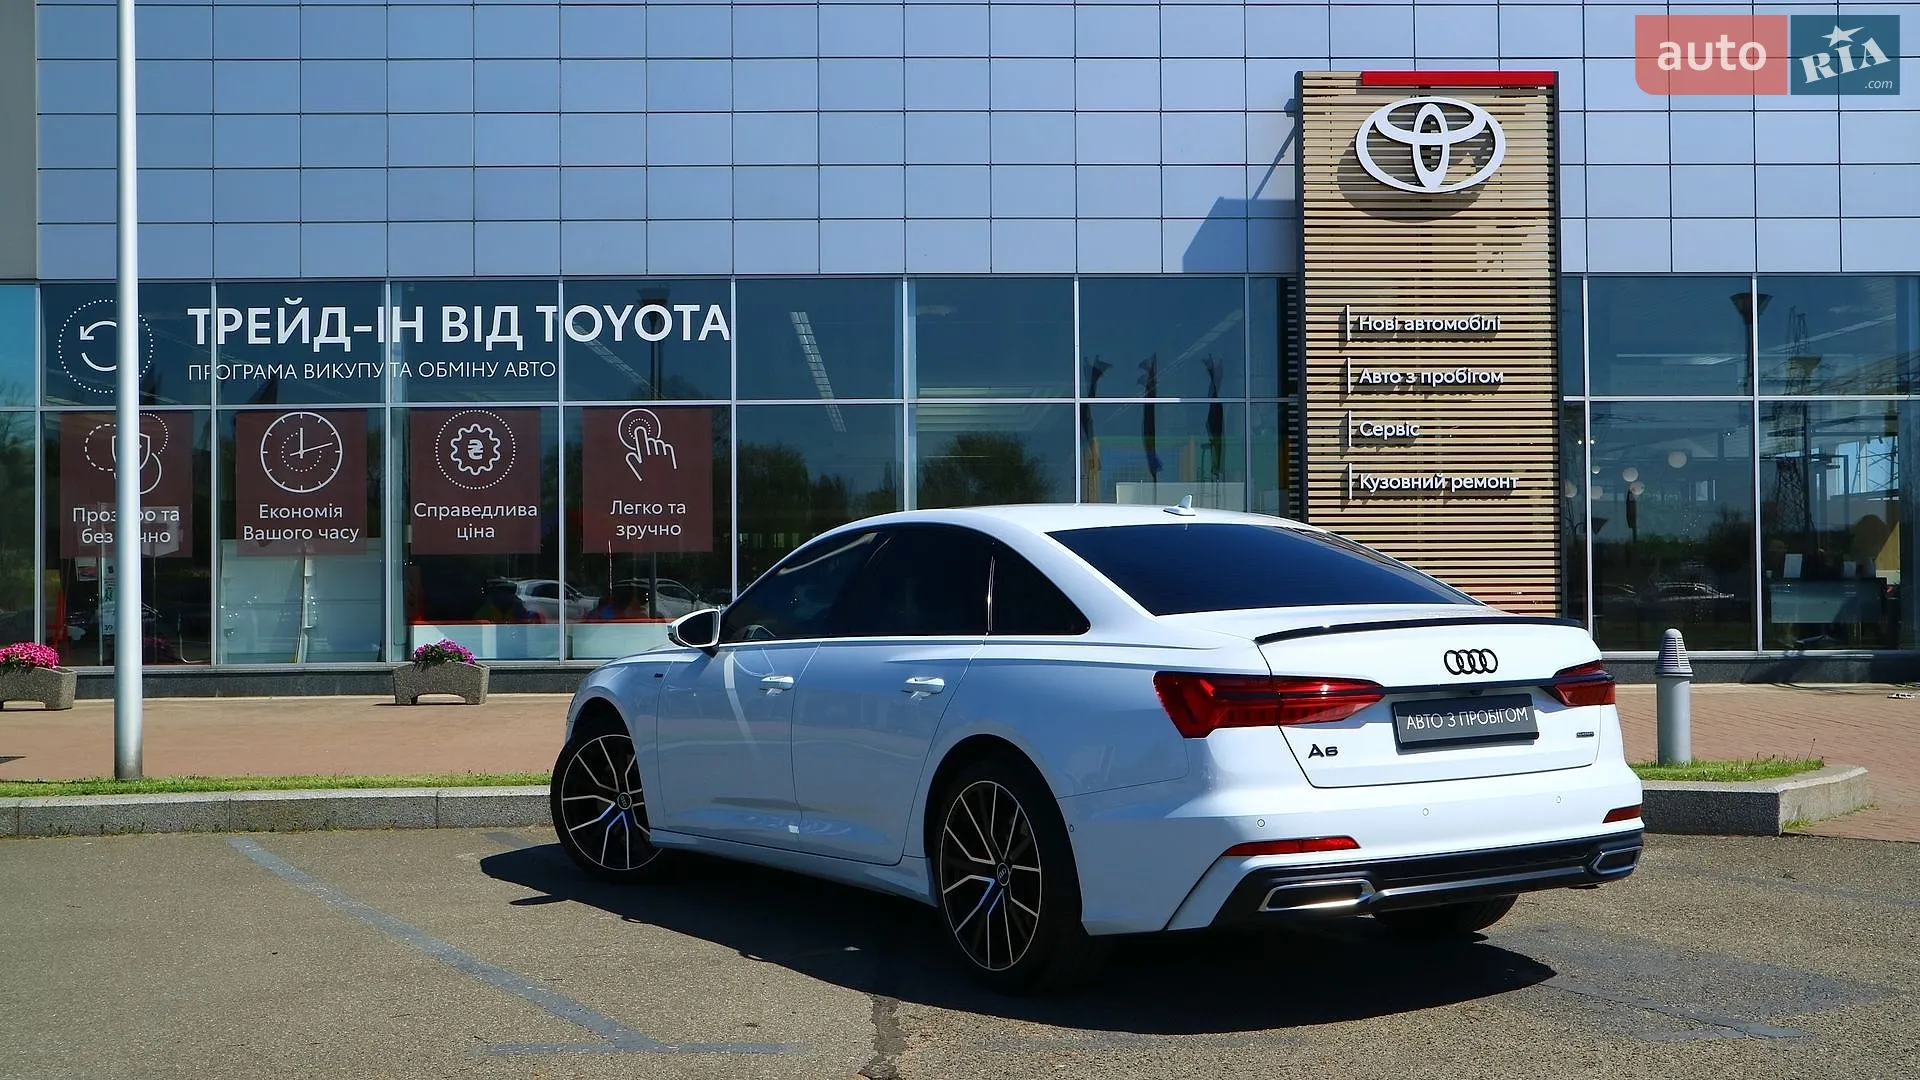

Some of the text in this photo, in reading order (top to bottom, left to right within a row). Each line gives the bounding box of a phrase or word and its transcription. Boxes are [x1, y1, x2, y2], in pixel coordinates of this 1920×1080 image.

[187, 297, 731, 352] ТРЕЙД-ІН ВІД TOYOTA
[1358, 314, 1501, 332] Нові автомобілі
[188, 360, 557, 381] ПРОГРАМА ВИКУПУ ТА ОБМІНУ АВТО
[1358, 367, 1504, 388] Авто з пробігом
[1359, 421, 1421, 440] Сервіс
[1359, 474, 1520, 493] Кузовний ремонт
[160, 511, 180, 521] та
[259, 503, 343, 519] Економія
[413, 502, 538, 520] Справедлива
[610, 500, 687, 517] Легко та
[81, 527, 171, 544] безчно
[243, 525, 360, 544] Вашого часу
[456, 522, 496, 540] ціна
[615, 523, 682, 540] зручно
[1406, 706, 1529, 730] АВТО З ПРОБІГОМ
[1308, 743, 1339, 759] A6
